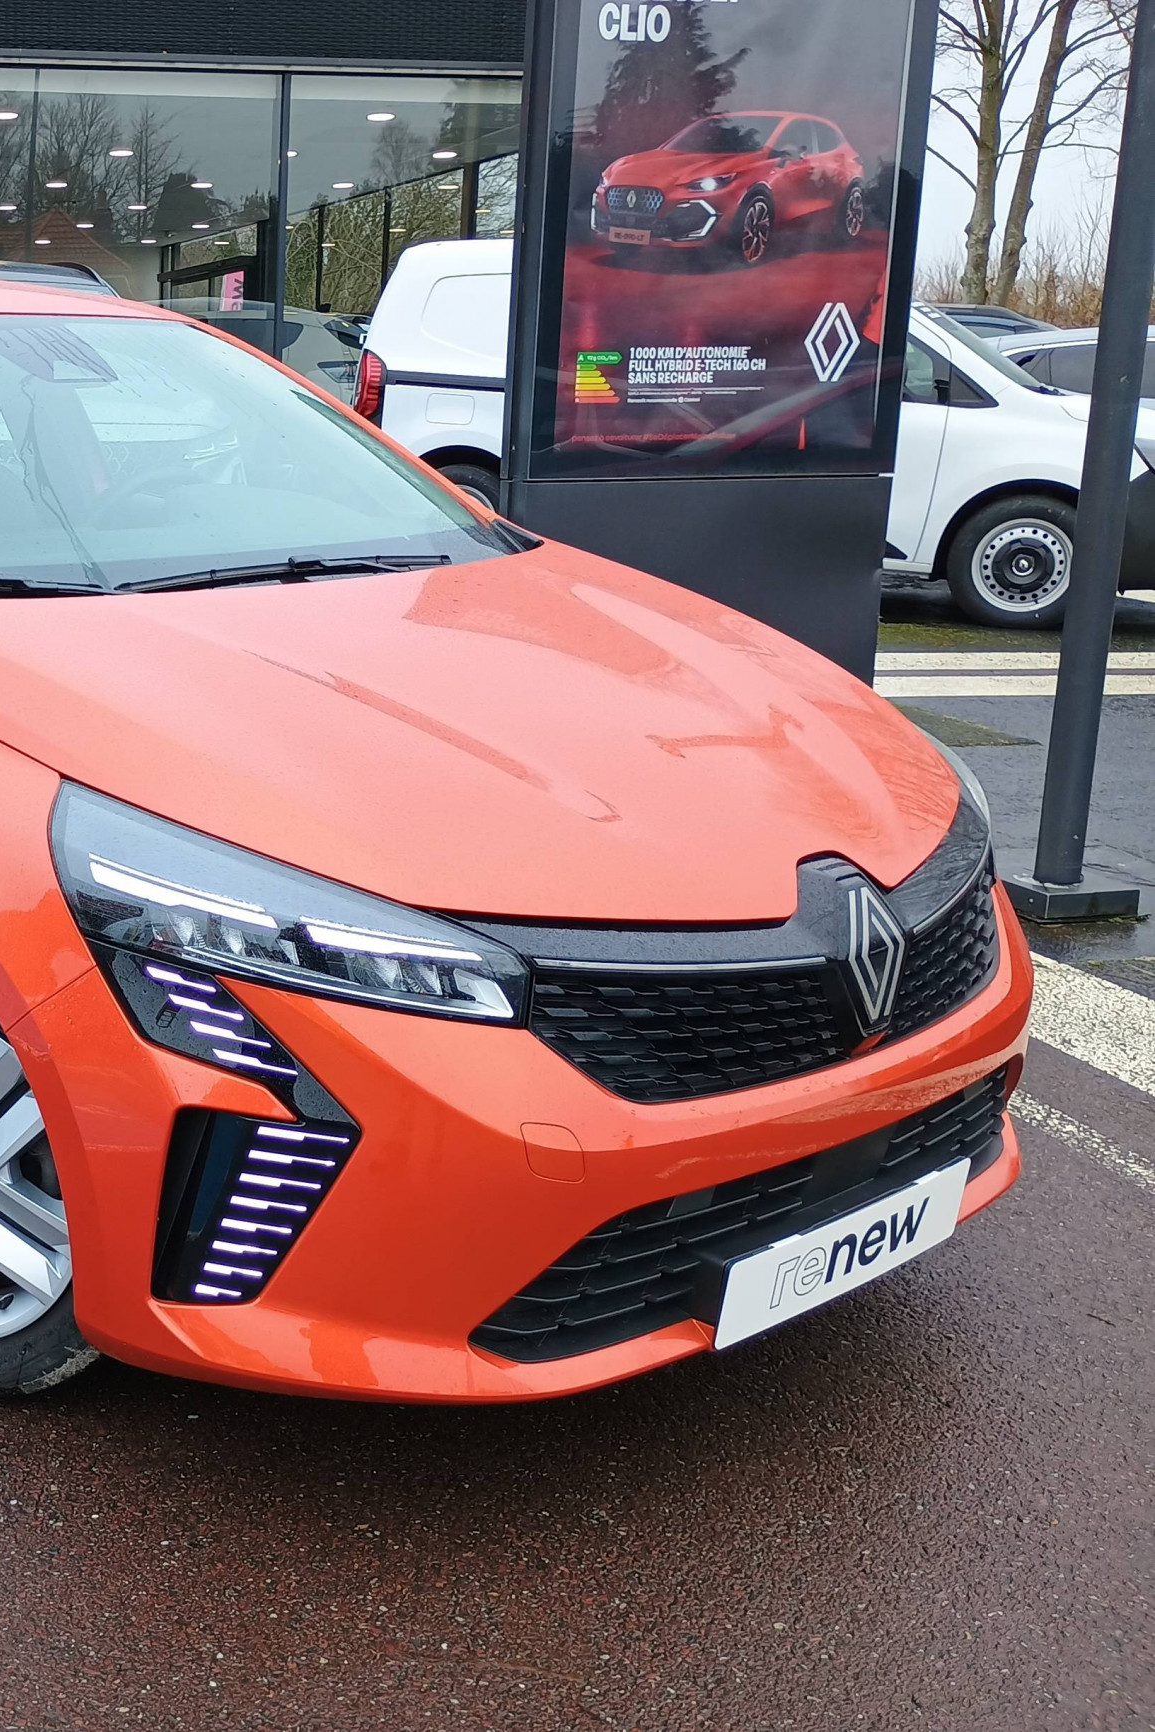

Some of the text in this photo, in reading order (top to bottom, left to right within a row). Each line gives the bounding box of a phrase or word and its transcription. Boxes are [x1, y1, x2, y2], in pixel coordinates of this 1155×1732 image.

[598, 2, 672, 43] CLIO
[657, 346, 675, 359] KM
[628, 358, 767, 372] FULL HYBRID E-TECH 160 CH
[627, 371, 714, 384] SANS RECHARGE
[768, 1195, 931, 1310] renew
